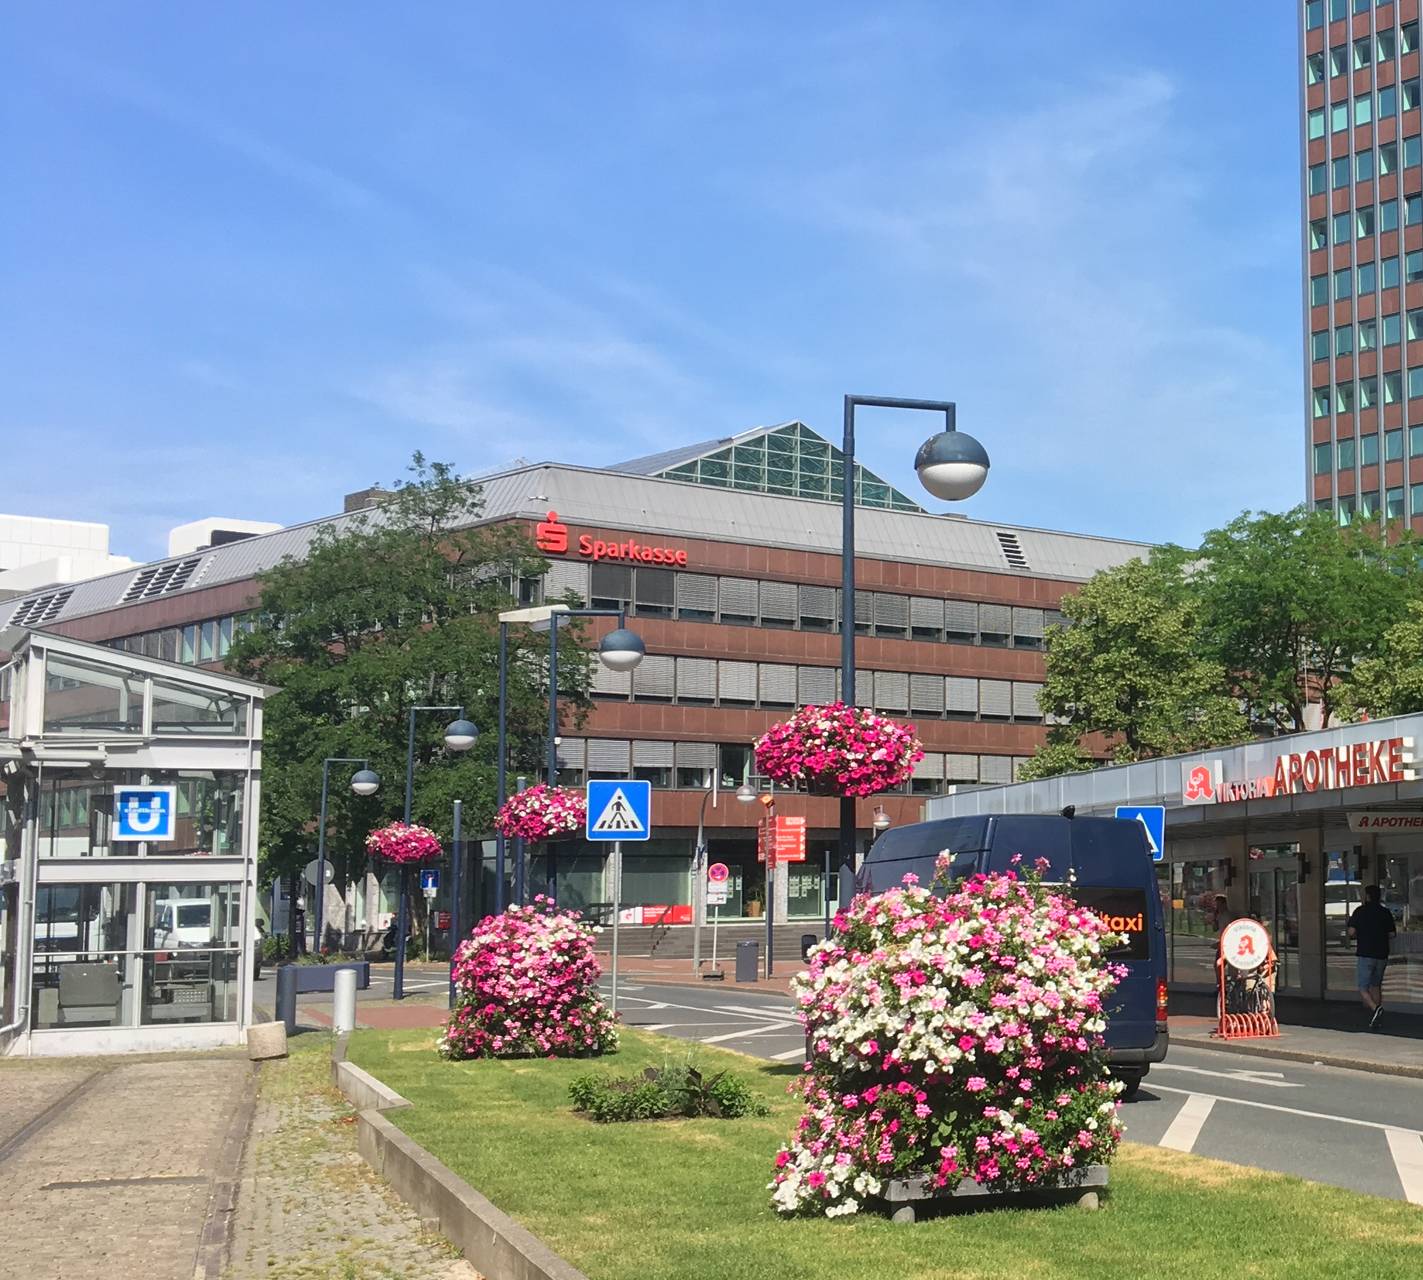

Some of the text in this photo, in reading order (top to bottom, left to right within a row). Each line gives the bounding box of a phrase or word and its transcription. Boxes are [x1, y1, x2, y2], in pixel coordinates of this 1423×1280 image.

[579, 534, 688, 564] Sparkasse
[1215, 776, 1267, 803] VIKTORIA
[1273, 737, 1405, 795] APOTHEKE
[128, 796, 161, 832] U
